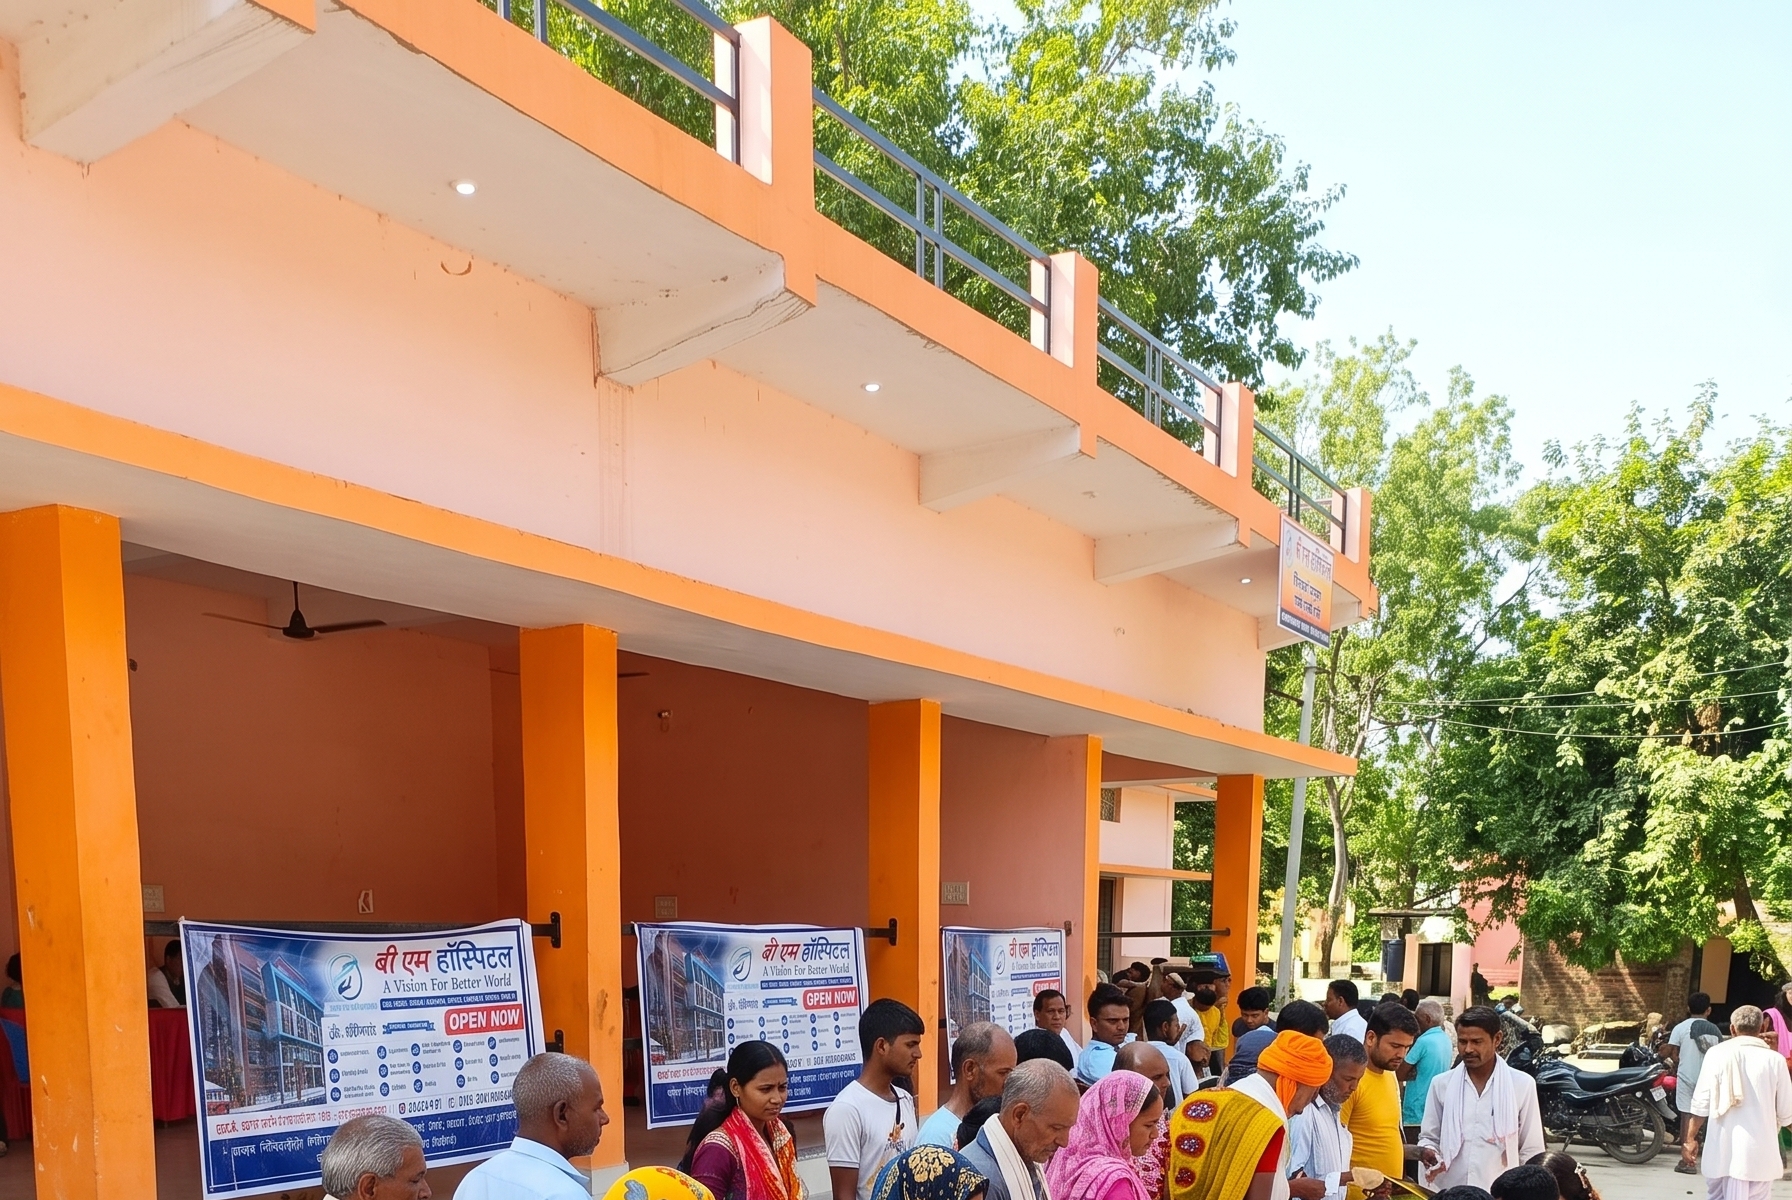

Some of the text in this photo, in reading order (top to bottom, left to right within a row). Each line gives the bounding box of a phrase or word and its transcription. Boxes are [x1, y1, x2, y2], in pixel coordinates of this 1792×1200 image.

[375, 940, 514, 976] बी एम हॉस्पिटल
[762, 937, 779, 962] बी
[762, 965, 769, 977] A
[383, 972, 512, 994] A Vision For Better World
[834, 990, 856, 1004] NOW
[449, 1010, 487, 1031] OPEN
[490, 1009, 520, 1027] NOW
